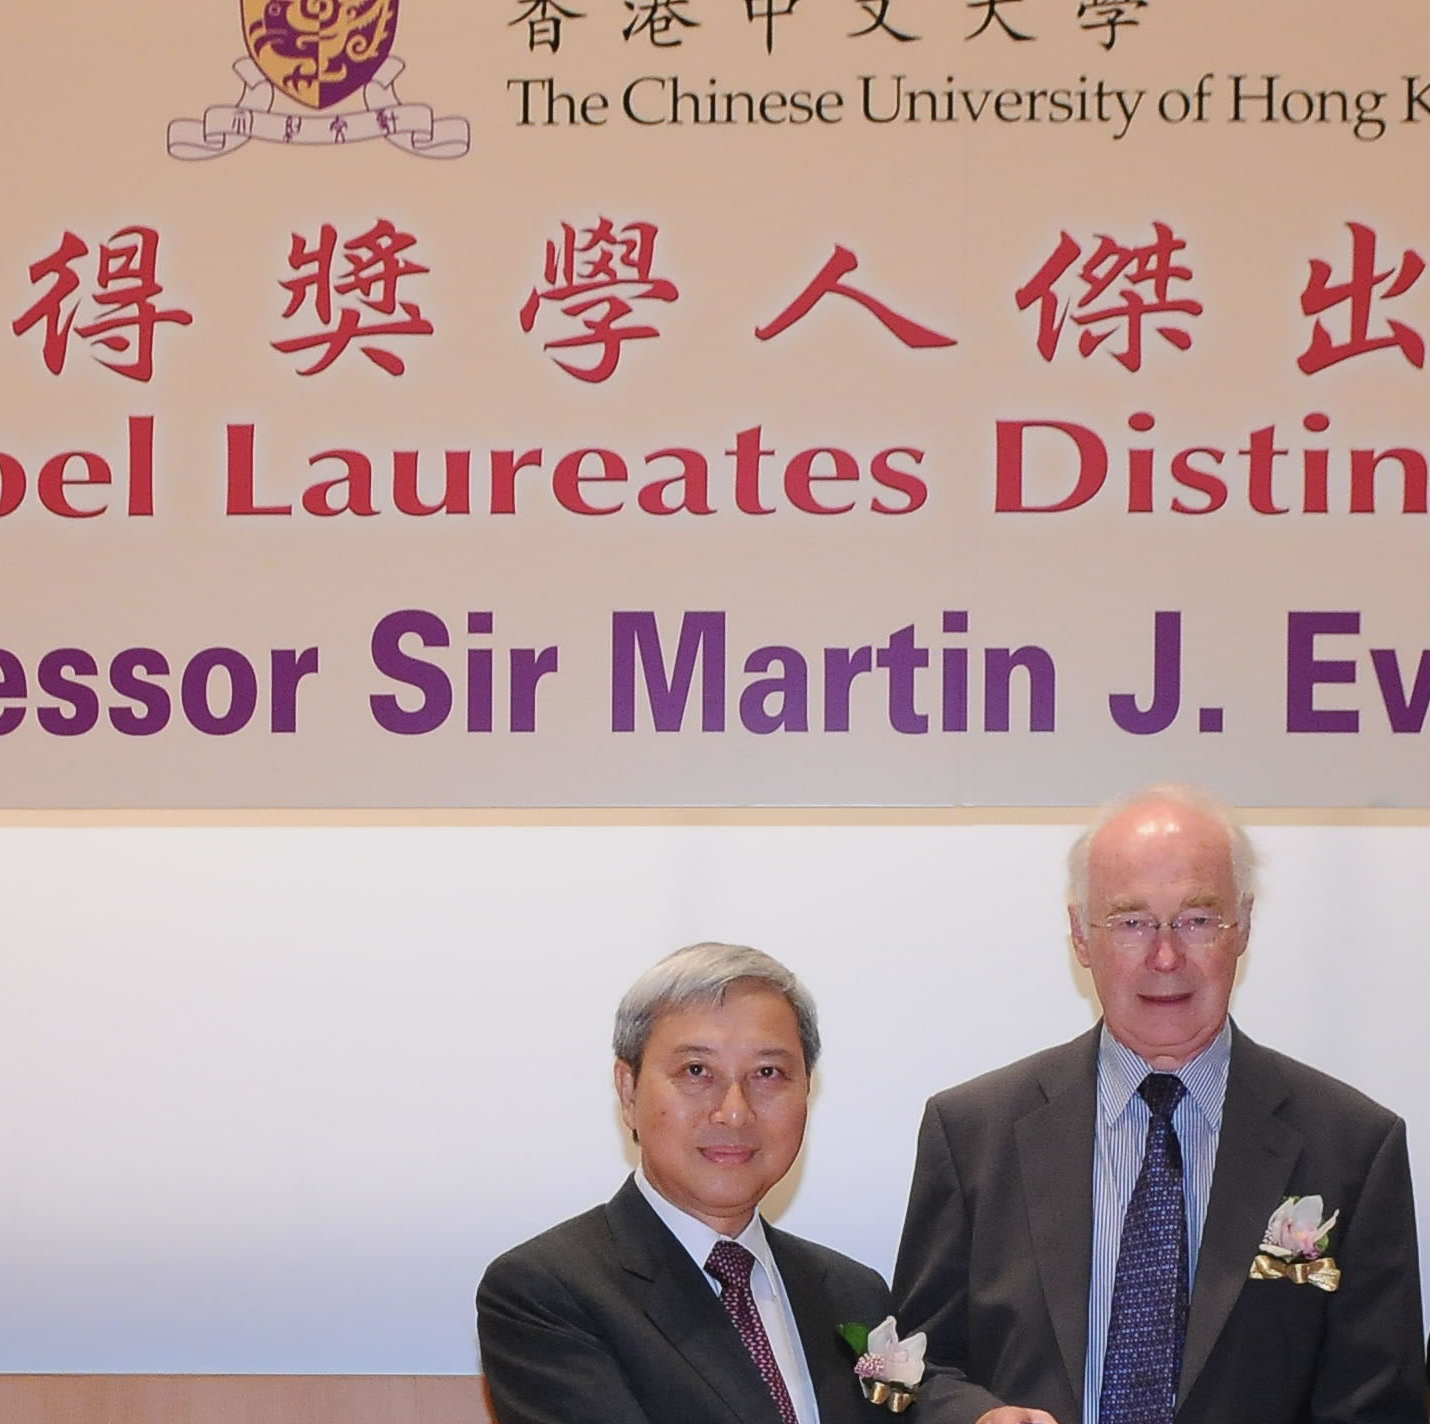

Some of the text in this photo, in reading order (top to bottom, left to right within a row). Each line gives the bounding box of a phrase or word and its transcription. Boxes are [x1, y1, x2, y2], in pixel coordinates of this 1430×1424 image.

[506, 77, 609, 127] The
[622, 75, 844, 126] Chinese
[859, 76, 1147, 141] University
[1158, 73, 1215, 123] of
[1229, 75, 1388, 140] Hong
[226, 424, 928, 517] Laureates
[369, 609, 558, 735] Sir
[611, 611, 1056, 735] Martin
[1108, 611, 1224, 735] J.
